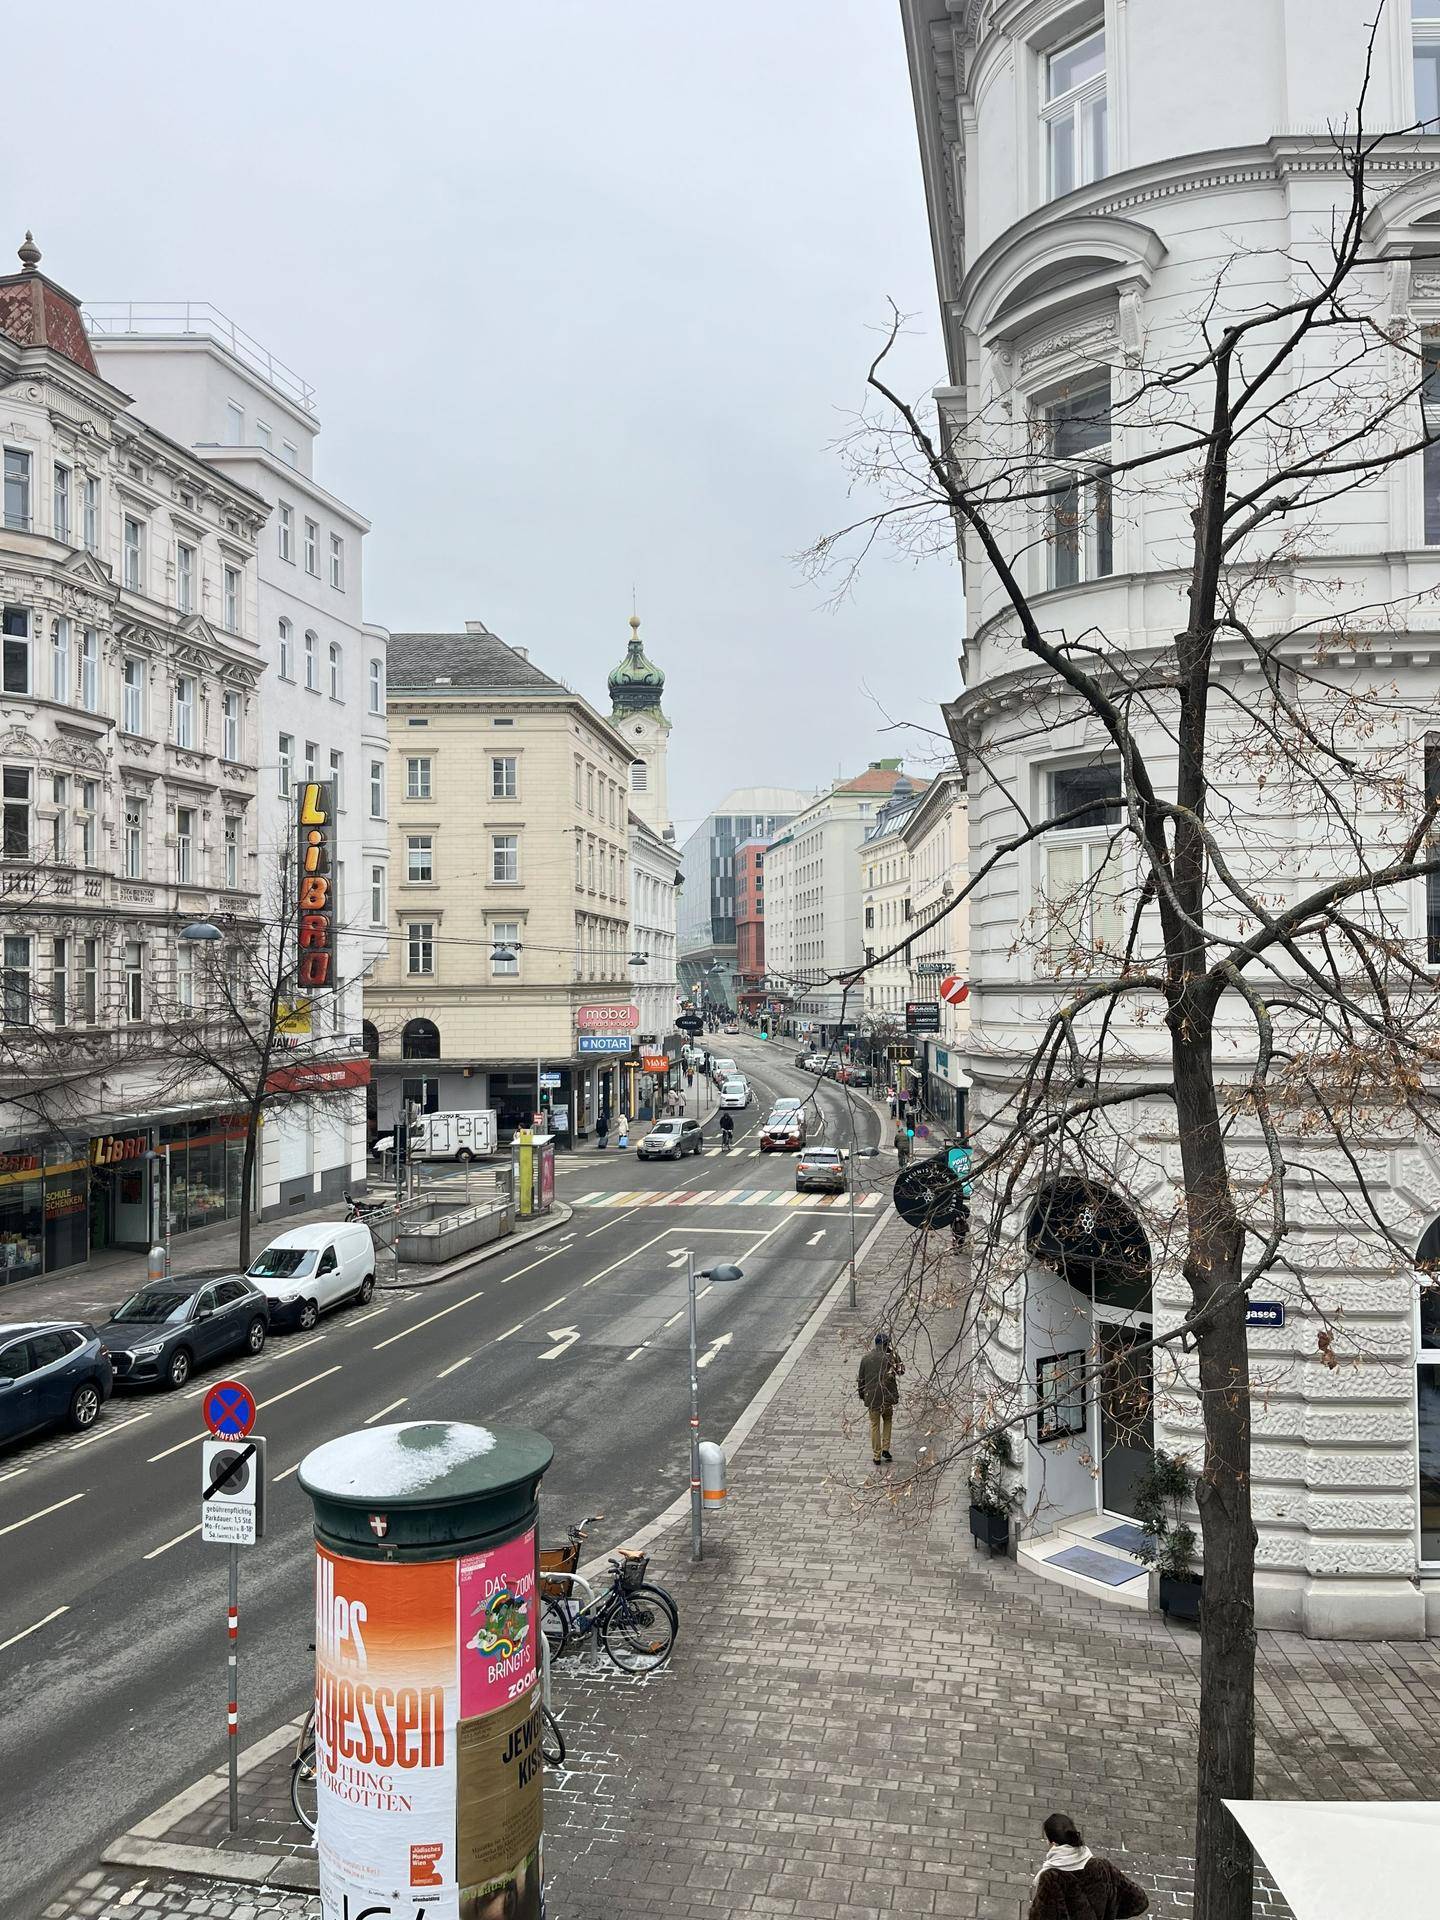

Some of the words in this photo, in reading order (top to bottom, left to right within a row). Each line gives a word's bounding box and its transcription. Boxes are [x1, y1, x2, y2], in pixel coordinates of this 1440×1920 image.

[586, 1007, 630, 1019] möbel
[590, 1038, 627, 1049] NOTAR
[46, 1188, 72, 1201] SCHULE
[46, 1195, 83, 1211] SCHENKEN
[215, 1429, 245, 1442] ANFANG
[206, 1506, 252, 1516] gebührenpflichtig
[485, 1573, 507, 1598] DAS
[514, 1569, 536, 1599] ZOOM
[487, 1645, 531, 1684] BRINGT'S
[518, 1747, 541, 1789] KIS
[319, 1765, 412, 1812] FORGOTTEN
[412, 1846, 441, 1854] Jüdisches
